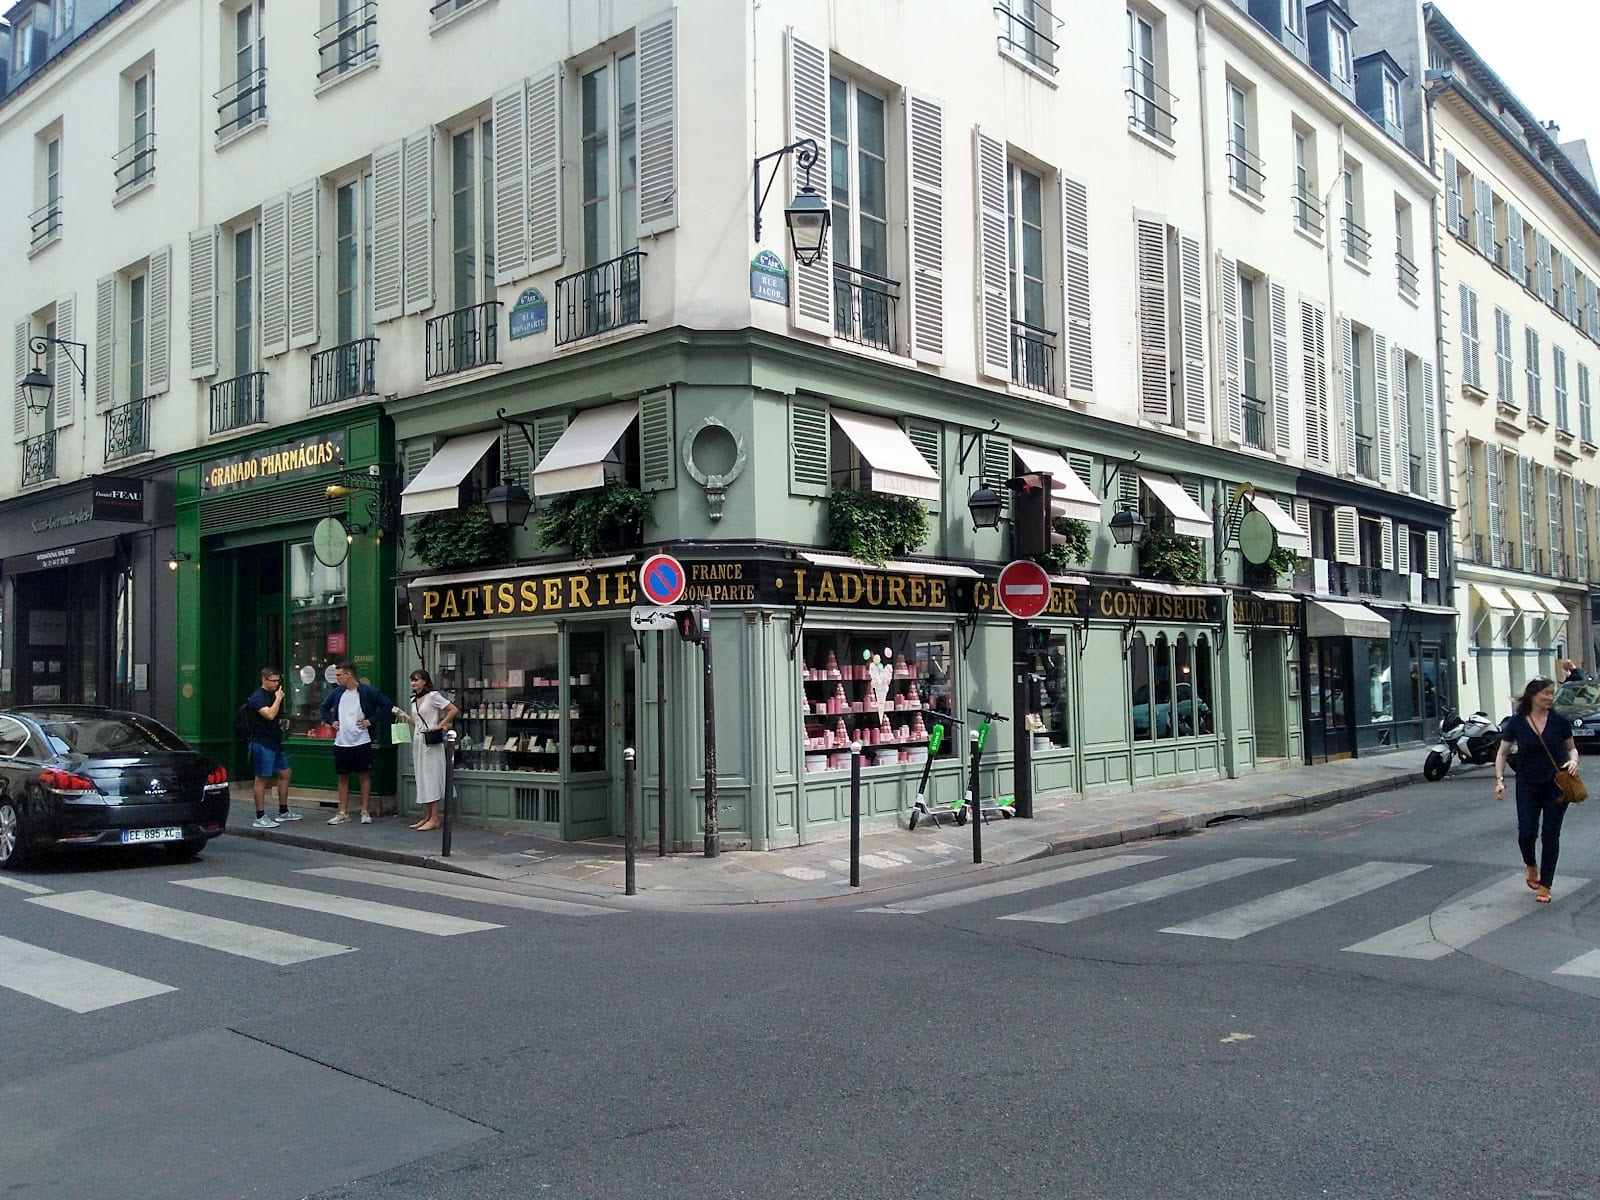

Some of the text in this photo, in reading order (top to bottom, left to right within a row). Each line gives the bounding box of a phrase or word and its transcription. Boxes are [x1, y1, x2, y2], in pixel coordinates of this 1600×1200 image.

[762, 276, 777, 288] RUE
[759, 285, 781, 298] JACOB
[522, 311, 535, 321] RUE
[211, 441, 333, 487] GRANADO PHARMÁCIAS
[112, 490, 142, 501] FEAU
[692, 563, 743, 580] FRANCE
[423, 570, 637, 619] PATISSERIE
[1100, 590, 1208, 620] CONFISEUR
[1233, 600, 1265, 622] SALON
